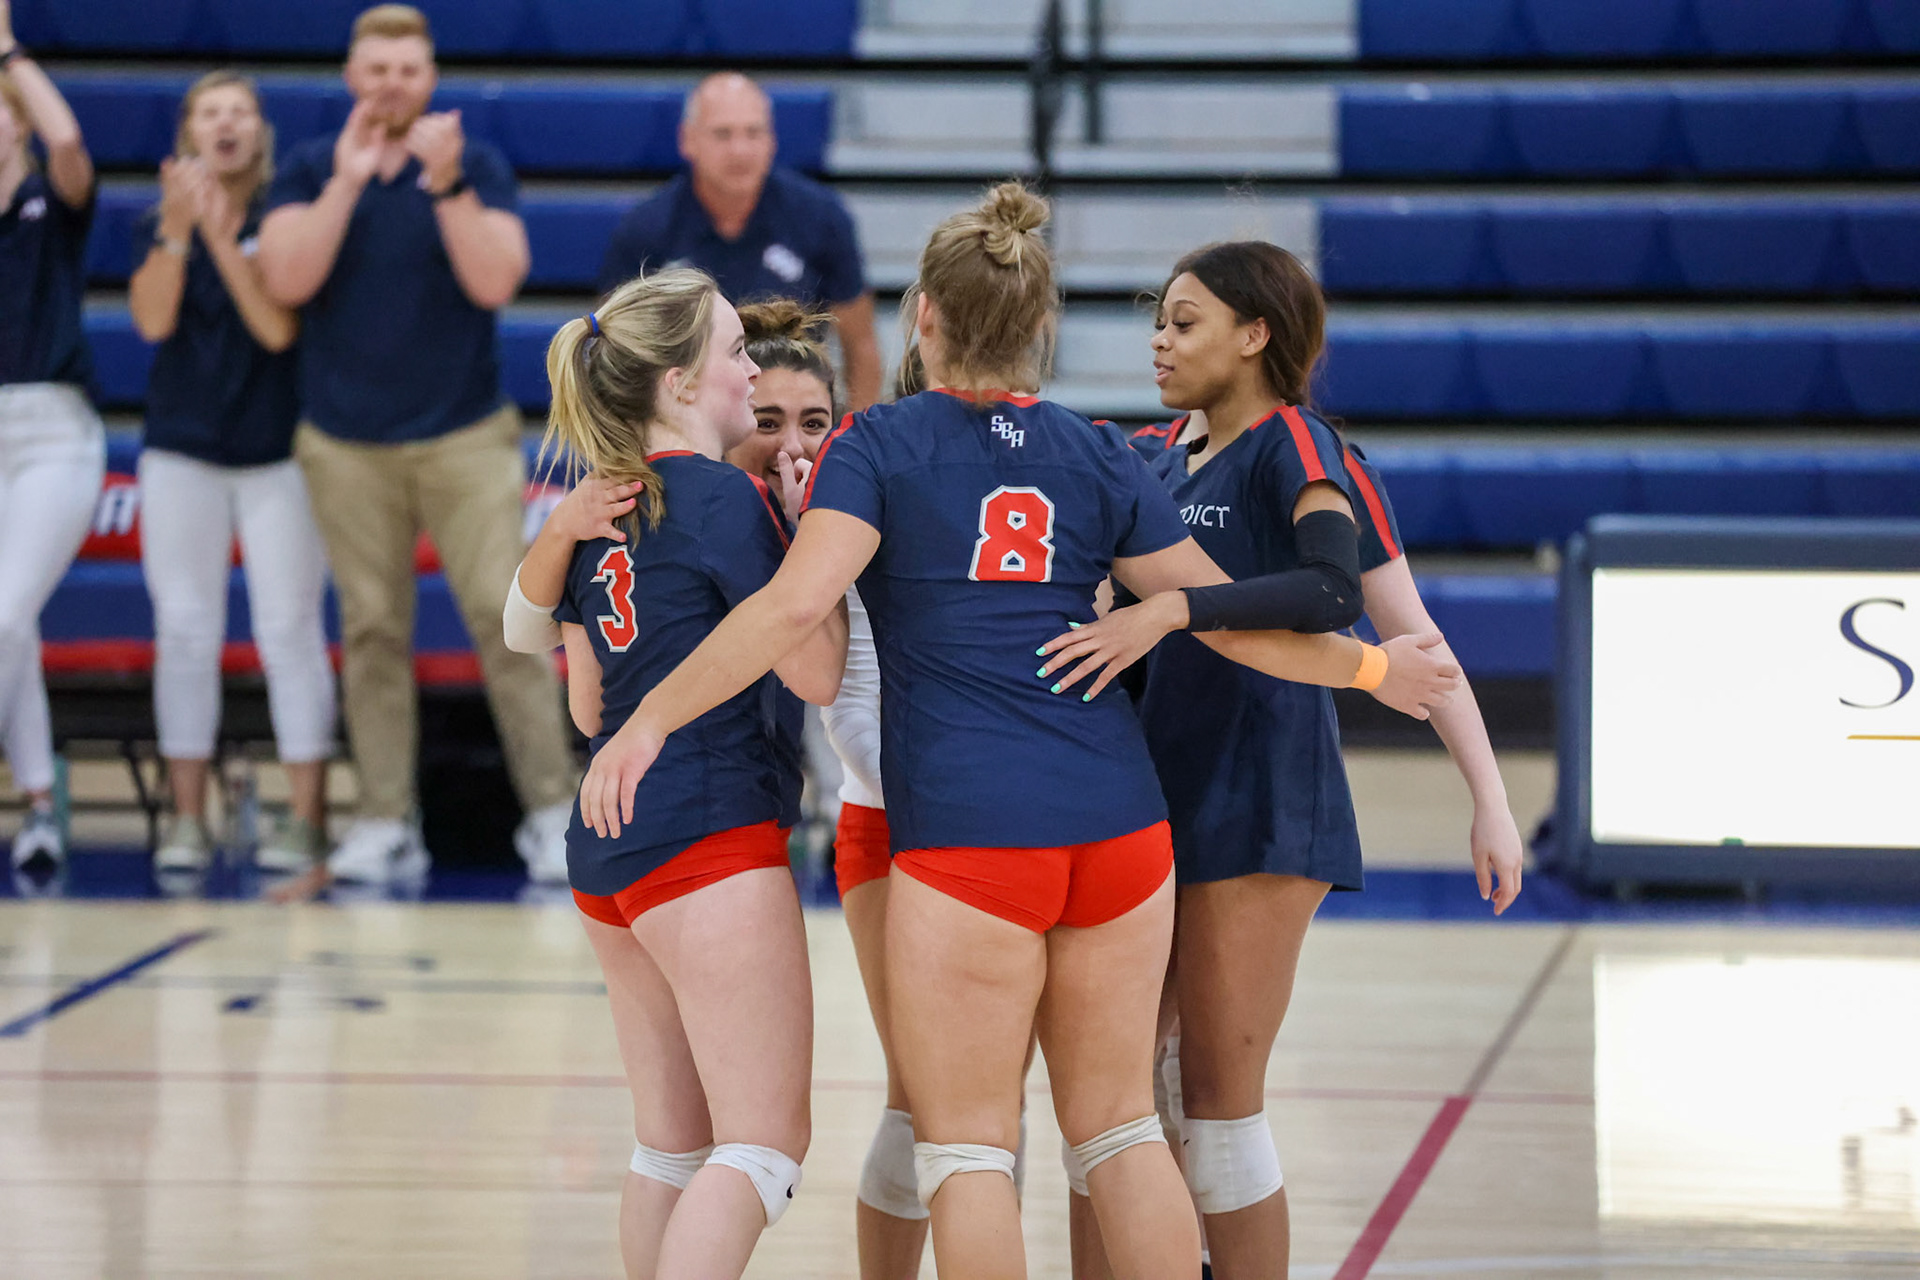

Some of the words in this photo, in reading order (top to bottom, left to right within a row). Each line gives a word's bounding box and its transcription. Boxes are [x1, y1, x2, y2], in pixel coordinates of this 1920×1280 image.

[990, 415, 1025, 448] SBA
[967, 484, 1056, 583] 8
[589, 544, 639, 653] 3
[1838, 597, 1915, 709] S
